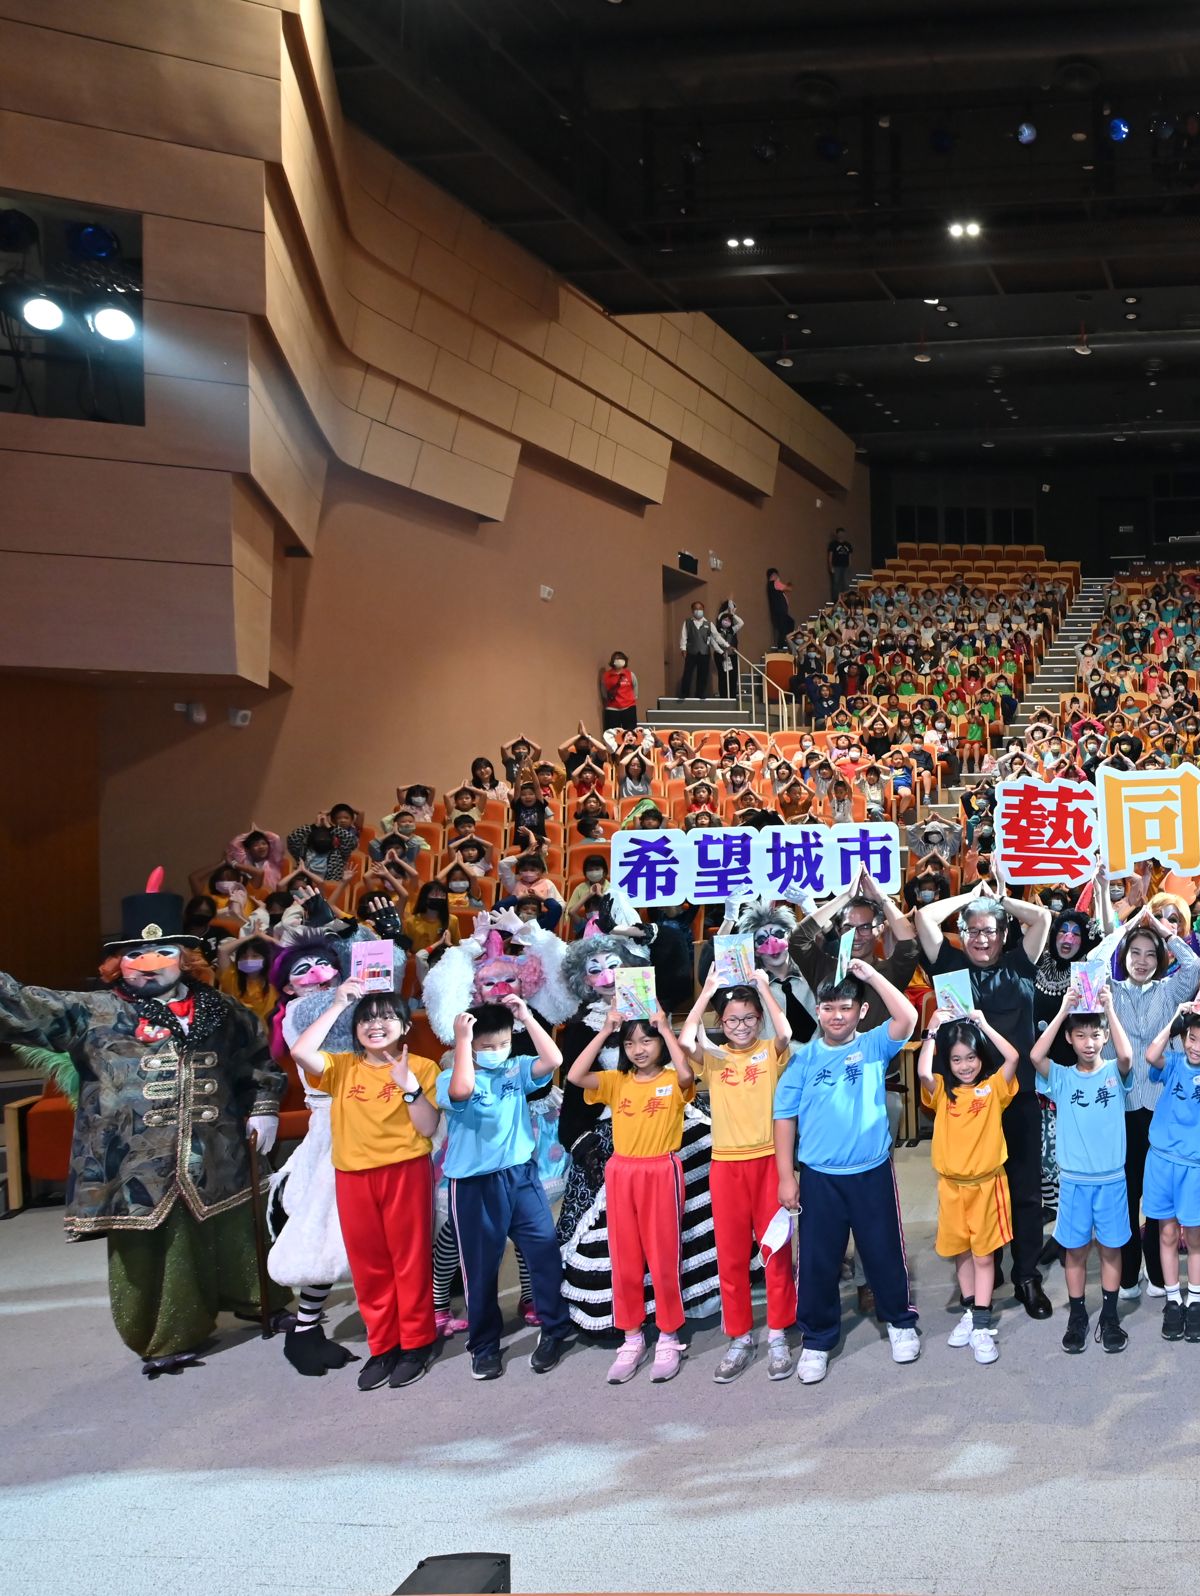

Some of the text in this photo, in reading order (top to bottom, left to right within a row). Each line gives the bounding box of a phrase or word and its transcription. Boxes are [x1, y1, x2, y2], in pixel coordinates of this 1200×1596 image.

[1001, 784, 1094, 880] 藝
[1104, 771, 1200, 872] 同
[618, 828, 893, 901] 希望城市
[720, 1064, 767, 1086] 光華
[813, 1063, 863, 1087] 光華
[616, 1096, 669, 1118] 光華
[1070, 1086, 1116, 1108] 光華
